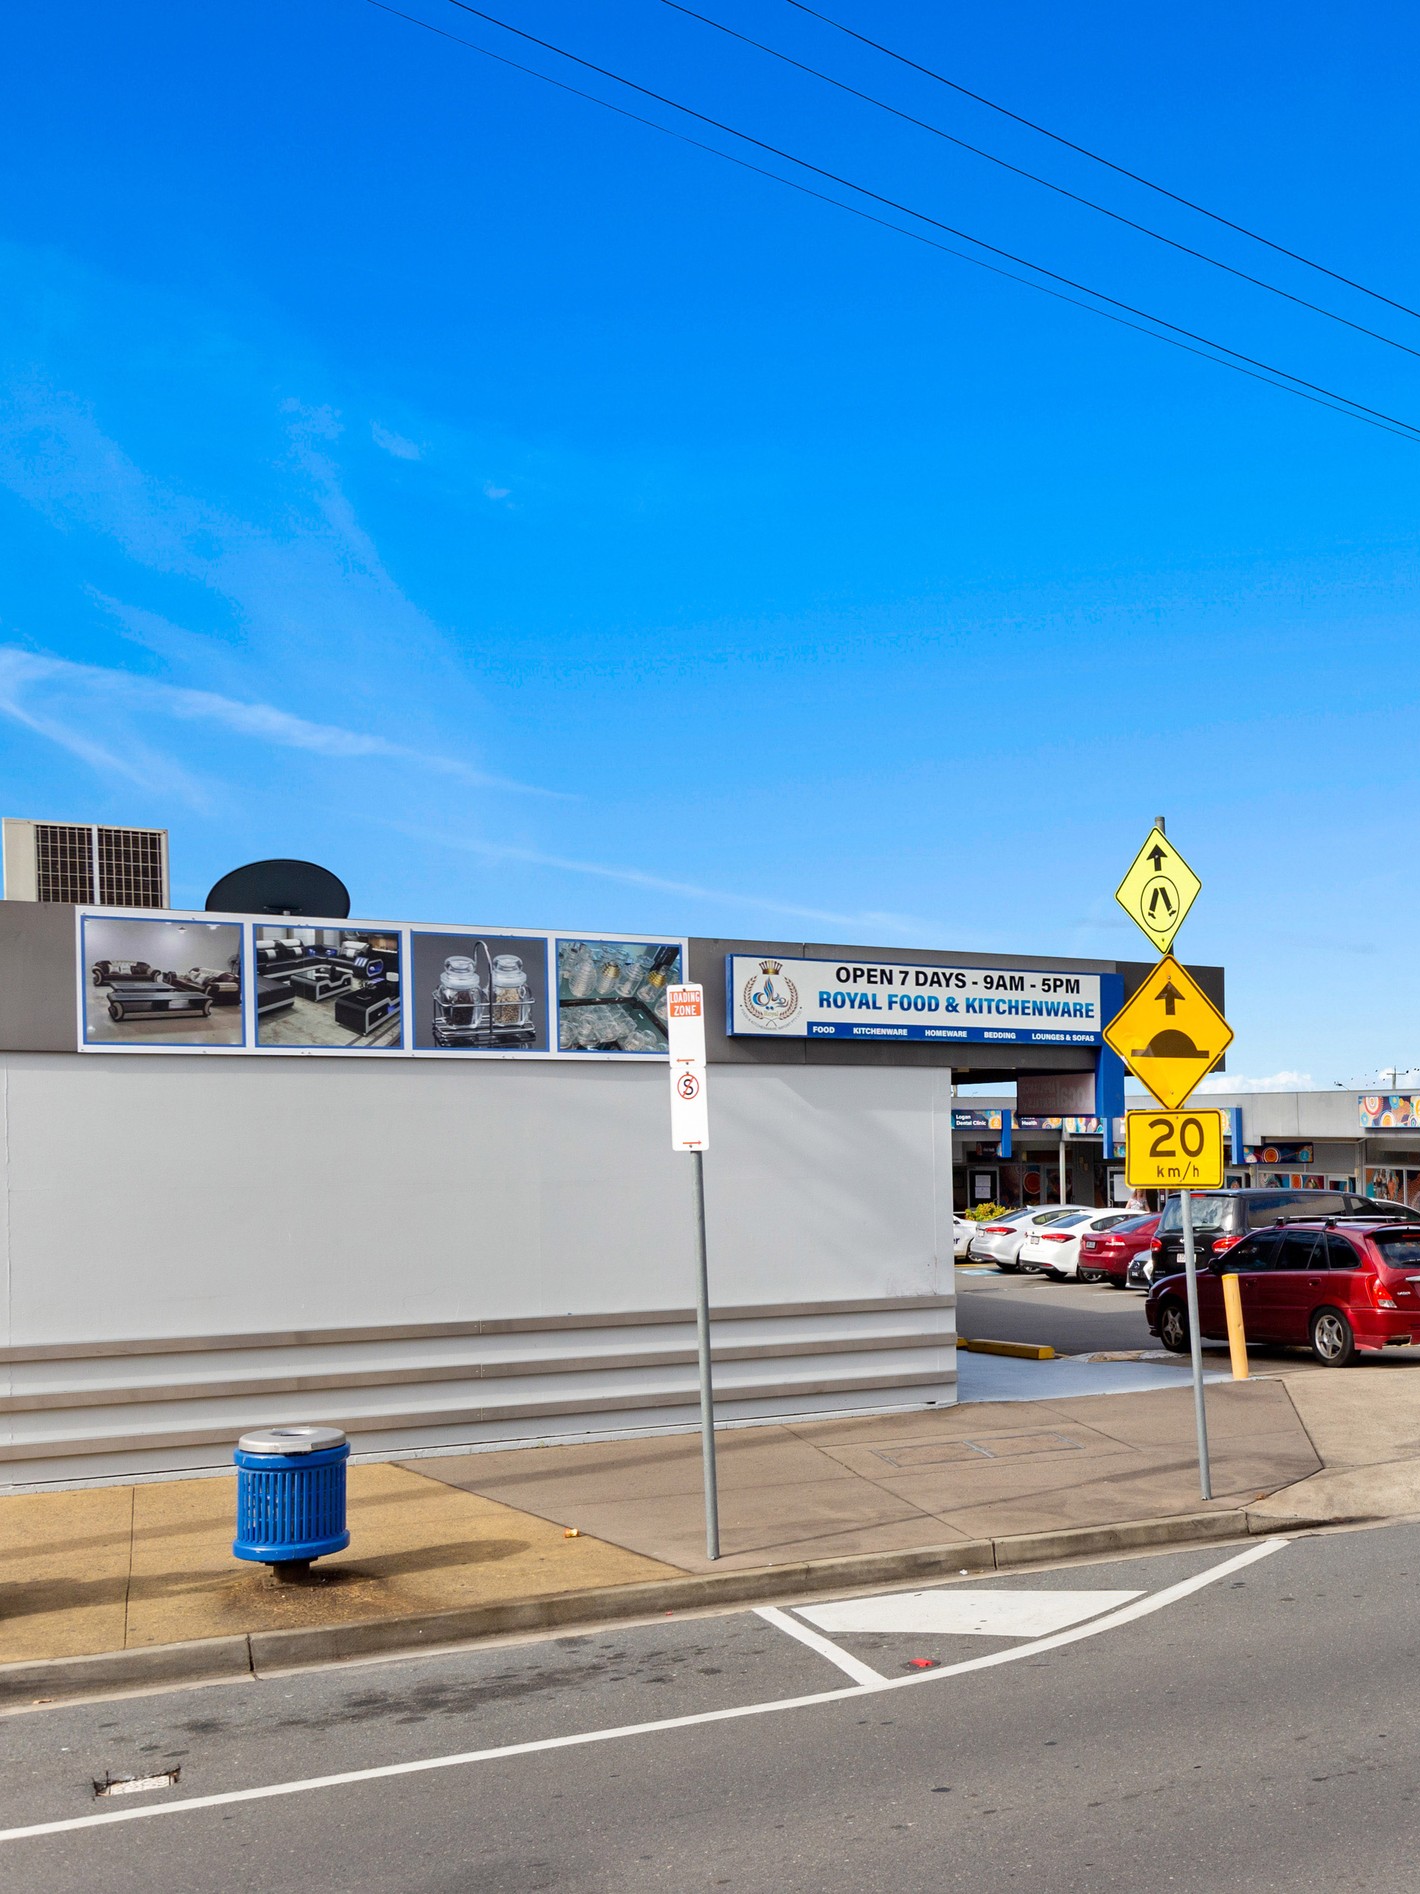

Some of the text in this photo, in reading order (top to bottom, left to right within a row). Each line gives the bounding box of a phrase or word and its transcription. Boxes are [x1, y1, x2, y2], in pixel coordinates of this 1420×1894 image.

[835, 966, 893, 985] OPEN
[899, 970, 909, 986] 7
[915, 970, 967, 989] DAYS
[983, 975, 1024, 992] 9AM
[1041, 978, 1080, 994] 5PM
[669, 991, 700, 1003] LOADING
[818, 991, 1095, 1018] ROYAL FOOD & KITCHENWARE
[673, 1005, 697, 1016] ZONE
[812, 1026, 835, 1034] FOOD
[853, 1027, 908, 1036] KITCHENWARE
[925, 1029, 967, 1038] HOMEWARE
[984, 1031, 1016, 1039] BEDDING
[1032, 1033, 1065, 1041] LOUNGES
[1072, 1034, 1095, 1042] SOFAS
[1148, 1118, 1204, 1158] 20
[1156, 1161, 1200, 1181] km/h
